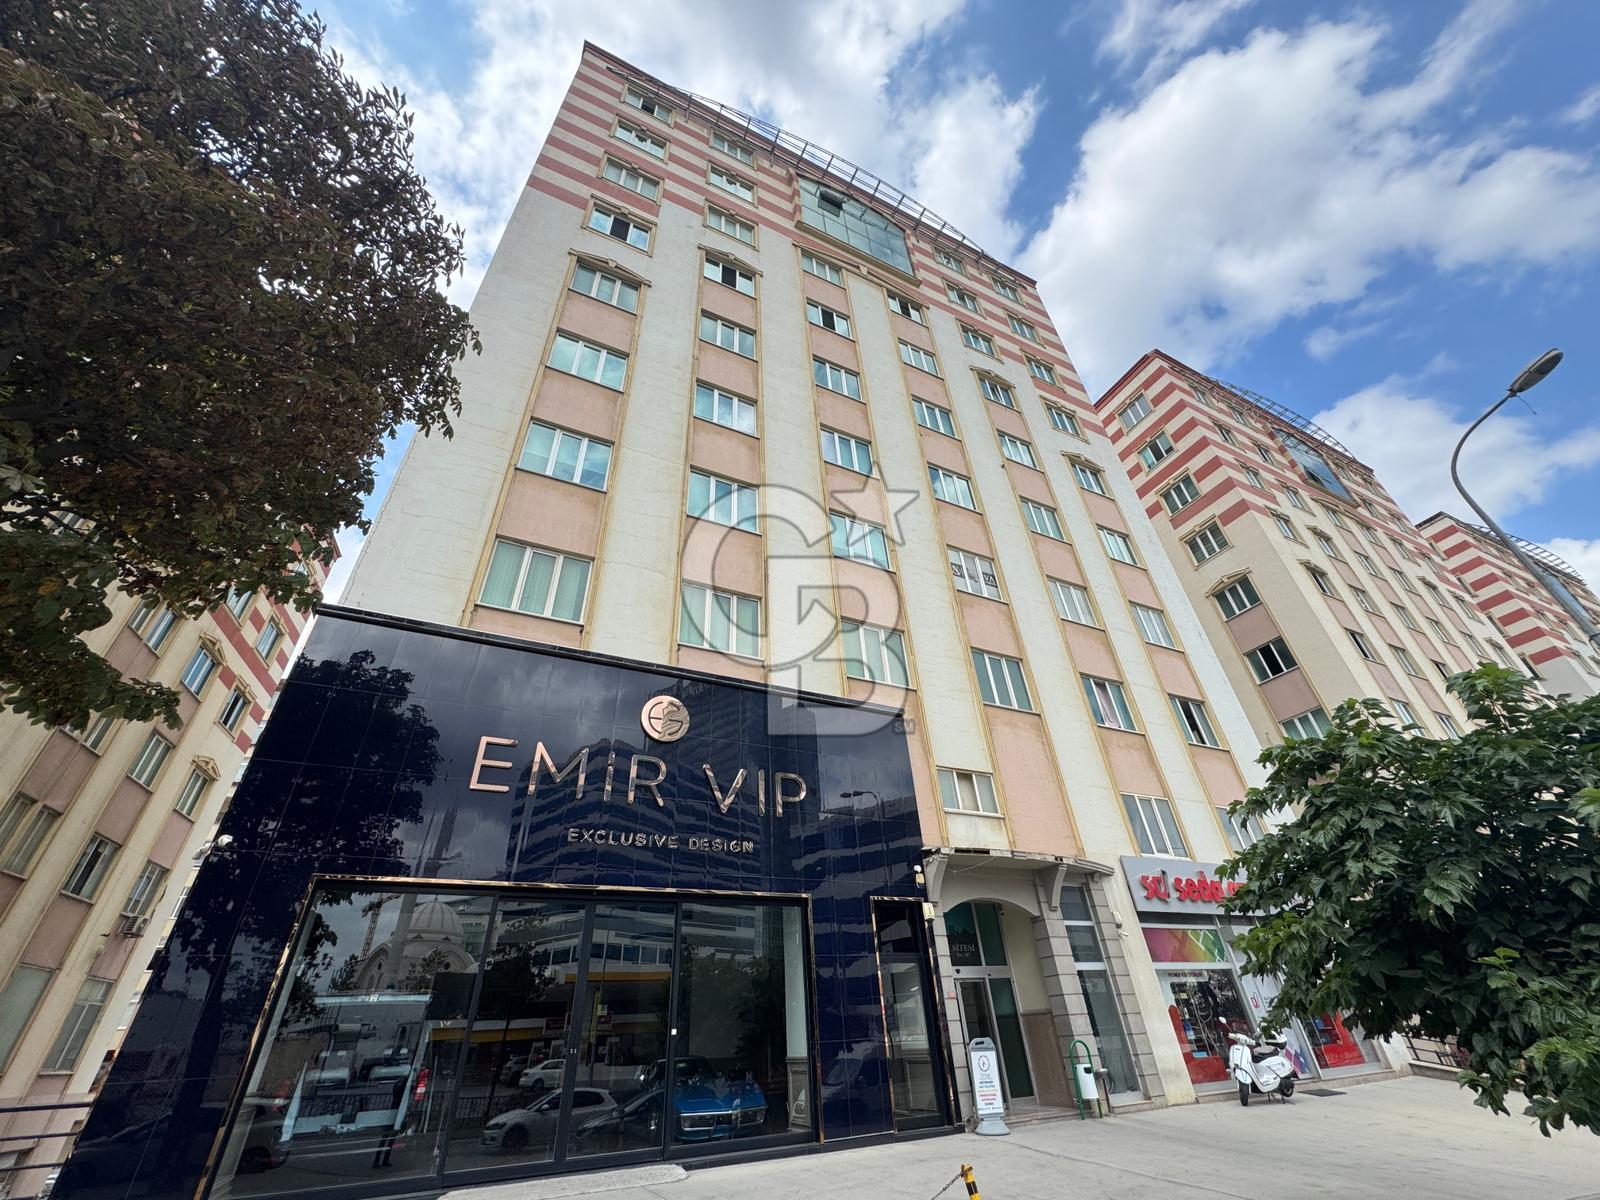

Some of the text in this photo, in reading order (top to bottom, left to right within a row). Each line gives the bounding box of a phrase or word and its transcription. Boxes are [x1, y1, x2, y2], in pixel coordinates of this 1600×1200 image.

[702, 763, 808, 818] VIP
[567, 828, 754, 853] EXCLUSIVE DESIGN
